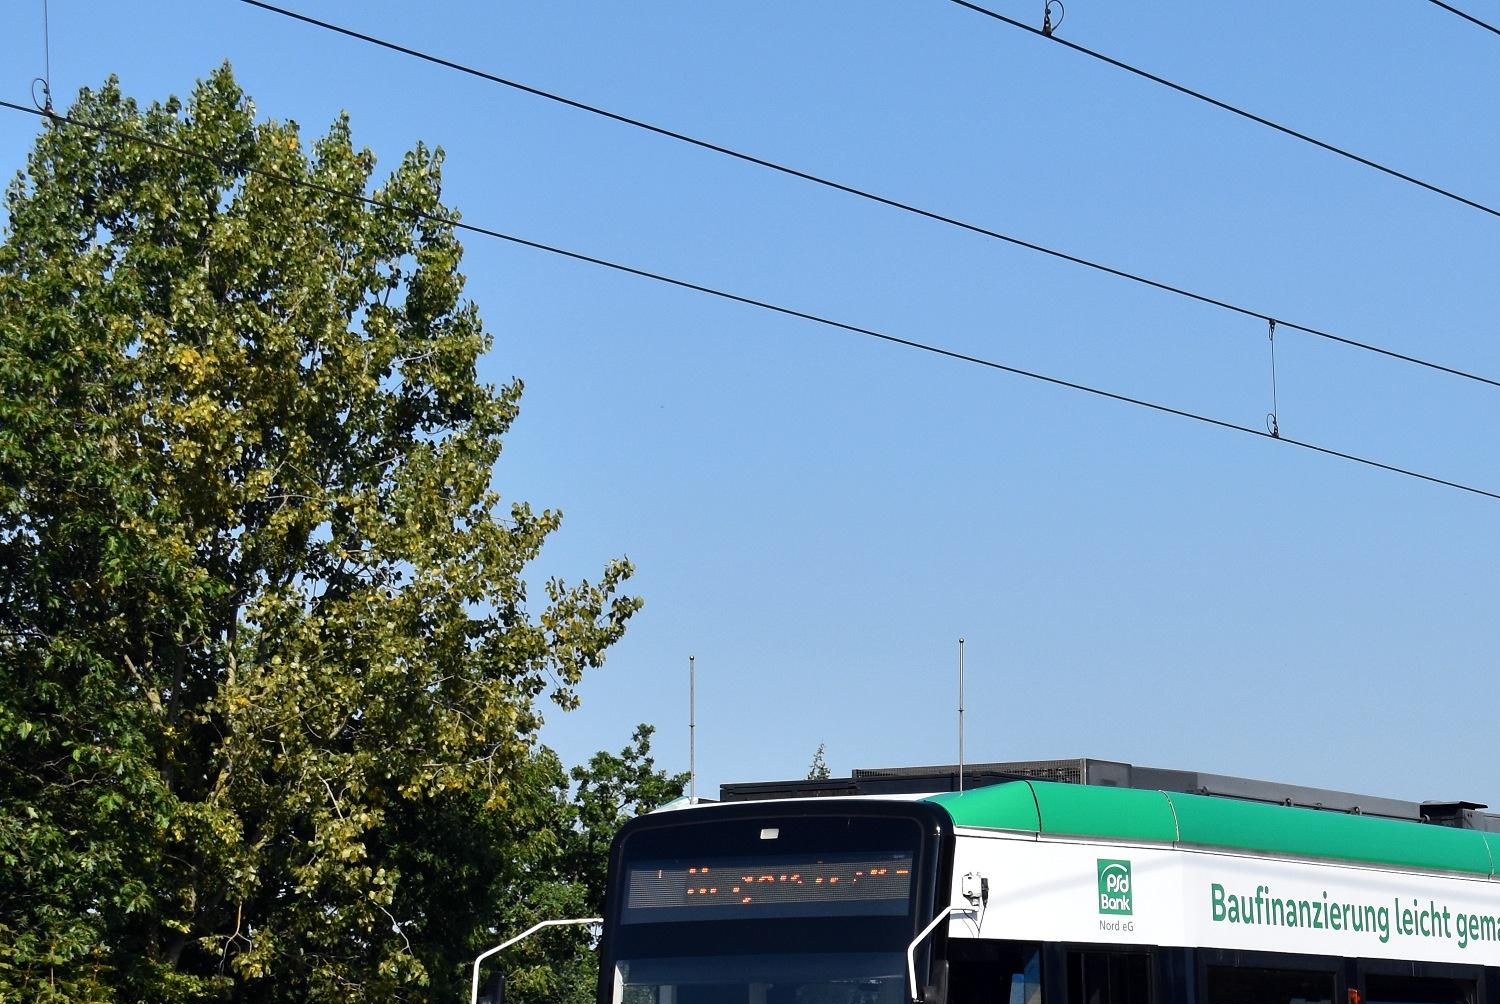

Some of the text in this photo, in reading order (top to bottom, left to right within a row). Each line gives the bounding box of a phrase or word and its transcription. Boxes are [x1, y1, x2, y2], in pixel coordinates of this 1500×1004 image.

[1107, 874, 1129, 893] psd
[1101, 894, 1130, 911] Bank
[1211, 883, 1389, 943] Baufinanzierung
[1396, 898, 1451, 937] leicht
[1100, 920, 1134, 931] Nord eG
